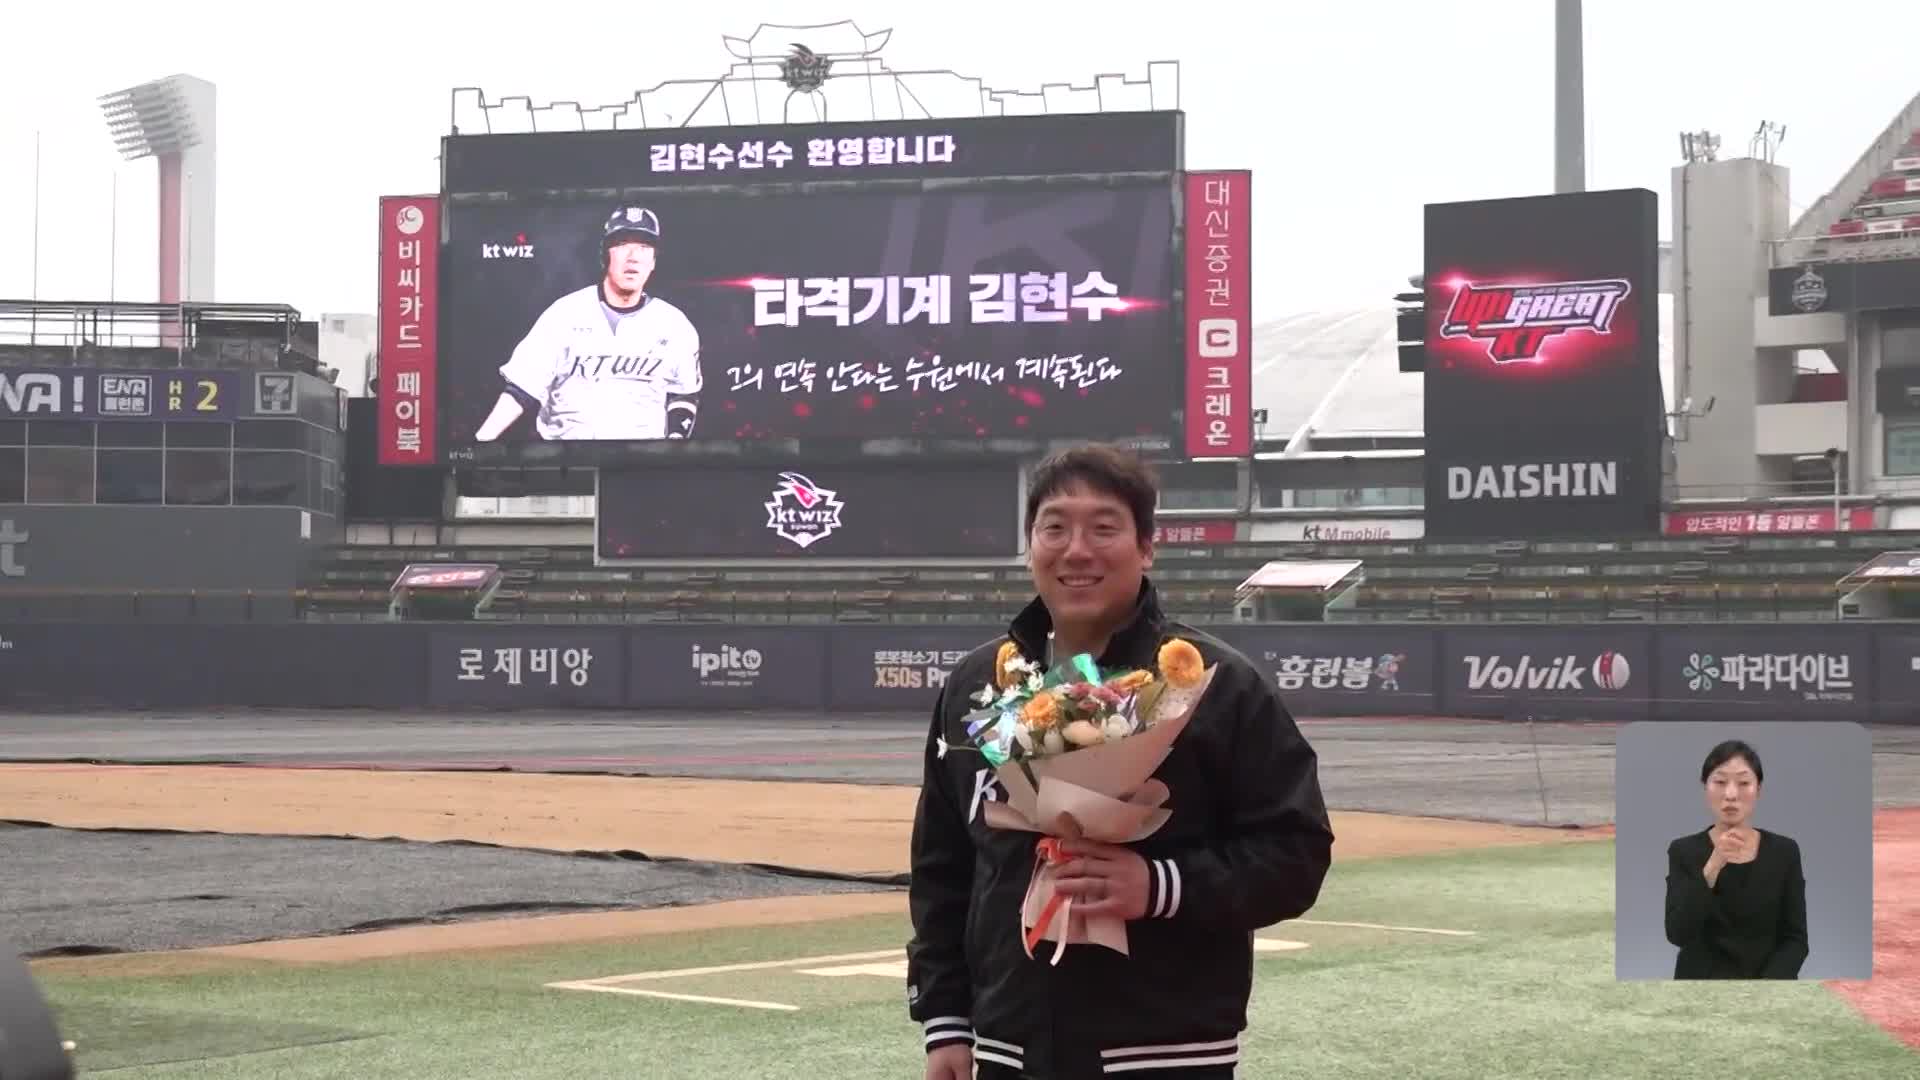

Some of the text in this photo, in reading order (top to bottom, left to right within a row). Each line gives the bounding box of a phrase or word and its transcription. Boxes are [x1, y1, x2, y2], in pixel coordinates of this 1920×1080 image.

[650, 135, 956, 172] 김현수선수 환영합니다
[483, 243, 534, 258] kt wiz
[1204, 180, 1231, 306] 대신증권
[753, 271, 1121, 327] 타격기계 김현수
[396, 240, 424, 454] 비씨카드 페이북
[726, 354, 1122, 392] 그의 연속 안타는 수원에서 계속된다
[196, 380, 218, 411] 2
[1204, 367, 1232, 446] 크레온
[1448, 462, 1616, 500] DAISHIN
[777, 507, 833, 522] kt wiz
[1303, 525, 1320, 540] kt
[1686, 516, 1742, 532] 압도적인
[457, 647, 593, 686] 로제비앙
[874, 667, 951, 689] X50s Pr
[1463, 656, 1586, 690] Volvik
[1721, 653, 1854, 691] 파라다이브
[968, 769, 998, 824] K
